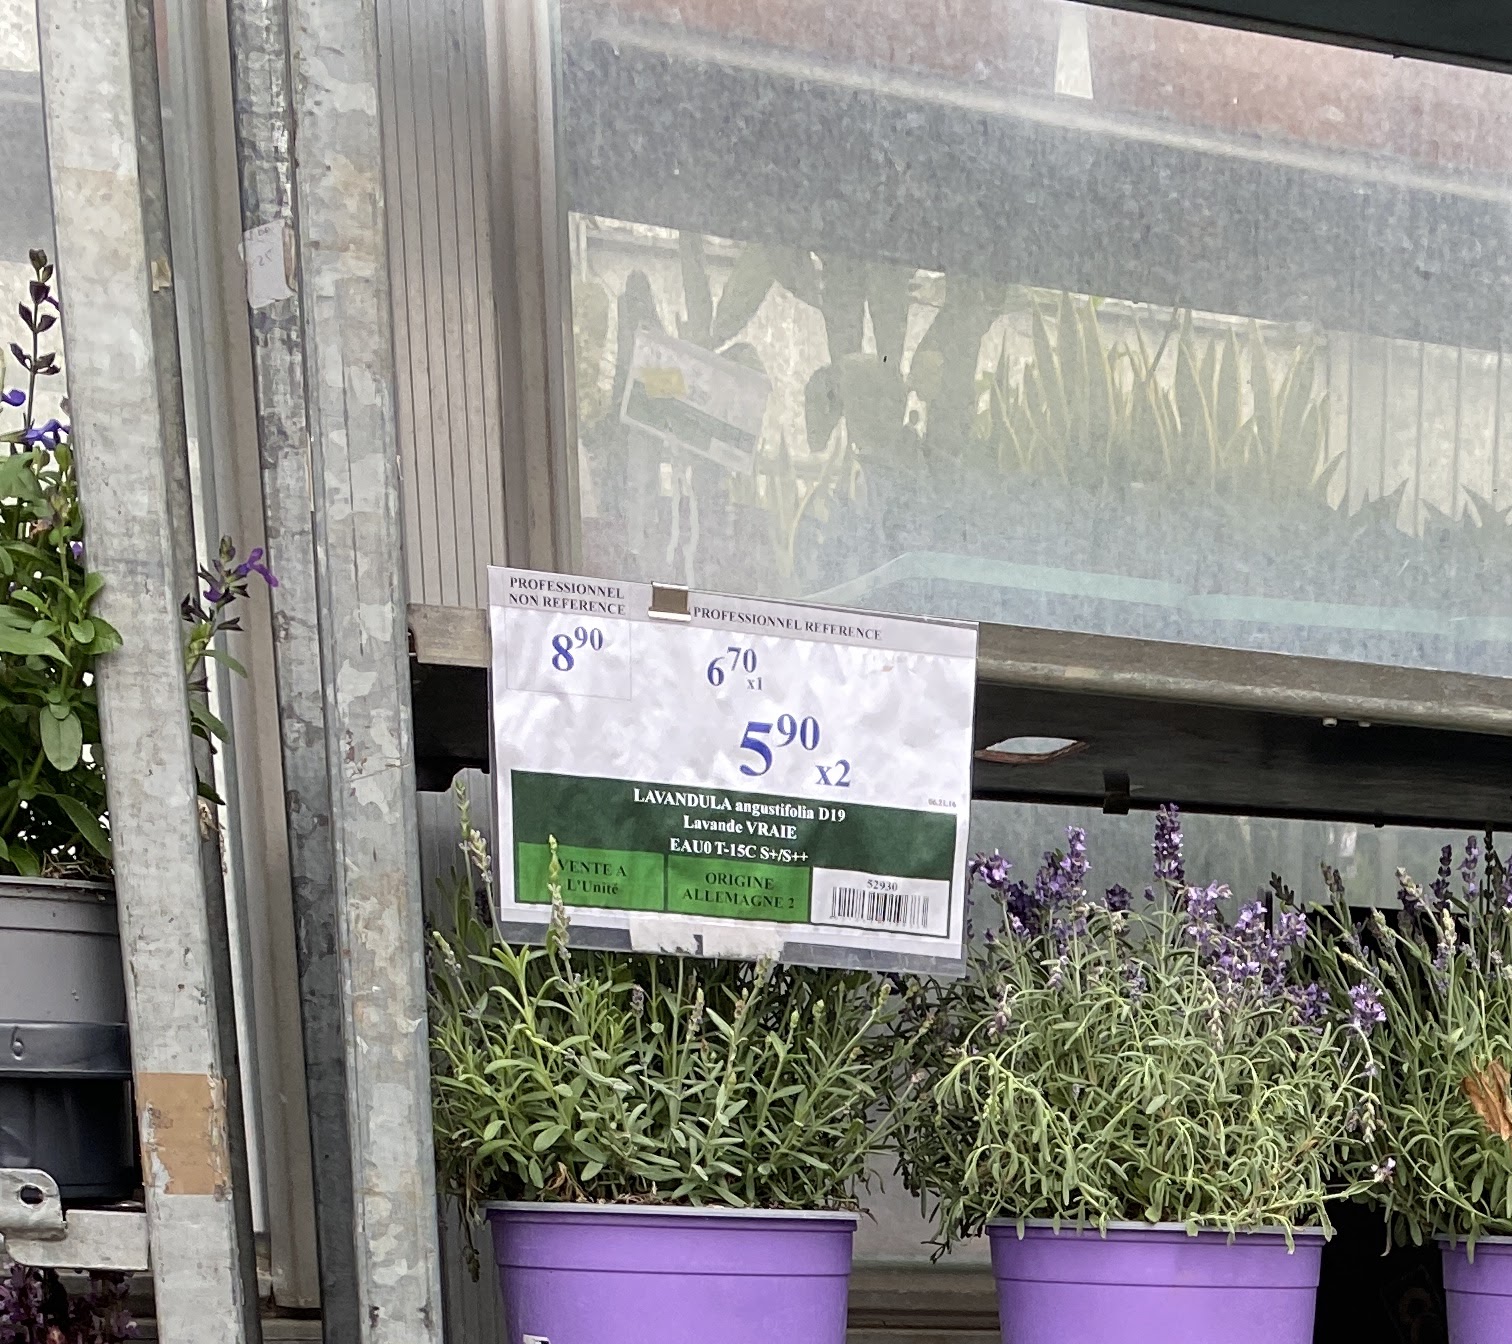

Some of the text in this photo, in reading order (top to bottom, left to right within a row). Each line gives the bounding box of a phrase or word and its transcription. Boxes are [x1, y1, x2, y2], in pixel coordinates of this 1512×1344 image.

[510, 576, 624, 600] PROFESSIONNEL
[509, 593, 626, 616] NON REFERENCE
[693, 606, 882, 640] PROFESSIONNEL REFERENCE
[815, 759, 851, 787] x2
[633, 788, 846, 822] LAVANDULA angustifolia D19
[683, 815, 797, 840] Lavande VRAIE
[715, 842, 757, 859] T-15C
[760, 846, 808, 863] S+/S++
[557, 857, 627, 877] VENTE A
[567, 878, 618, 895] L'Unité
[705, 872, 775, 890] ORIGINE
[867, 879, 898, 891] 52930
[682, 887, 784, 909] ALLEMAGNE
